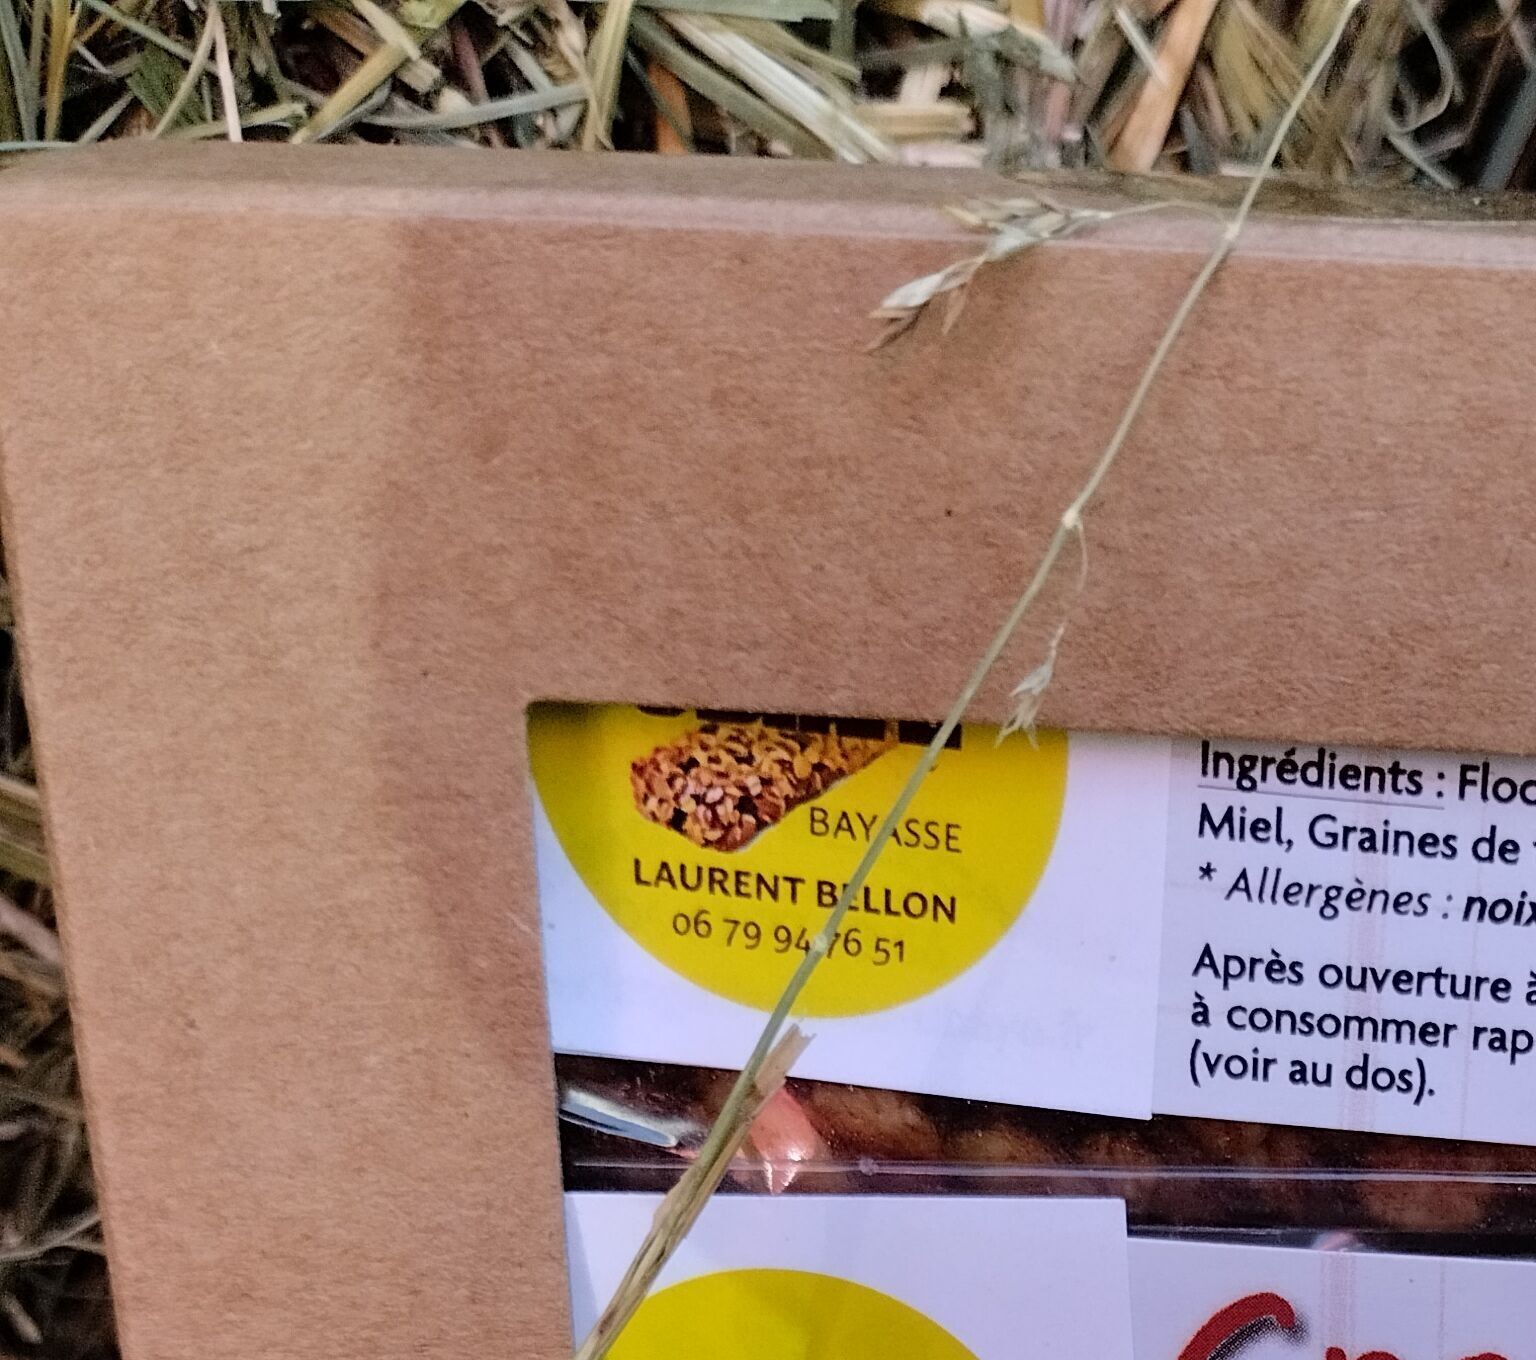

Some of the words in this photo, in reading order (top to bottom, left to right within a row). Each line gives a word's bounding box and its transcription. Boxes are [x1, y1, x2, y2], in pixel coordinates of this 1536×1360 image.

[1199, 740, 1424, 796] Ingrédients
[1198, 802, 1294, 854] Miel,
[1308, 813, 1459, 861] Graines
[1471, 825, 1521, 865] de
[633, 857, 806, 905] LAURENT
[1224, 864, 1432, 921] Allergènes
[672, 909, 713, 939] 06
[722, 918, 761, 950] 79
[772, 924, 811, 956] 94
[872, 937, 905, 967] 51
[1191, 942, 1304, 990] Après
[1317, 959, 1512, 1004] ouverture
[1190, 991, 1210, 1028] à
[1225, 1003, 1458, 1049] consommer
[1188, 1038, 1278, 1088] (voir
[1288, 1060, 1333, 1087] au
[1344, 1052, 1436, 1106] dos).
